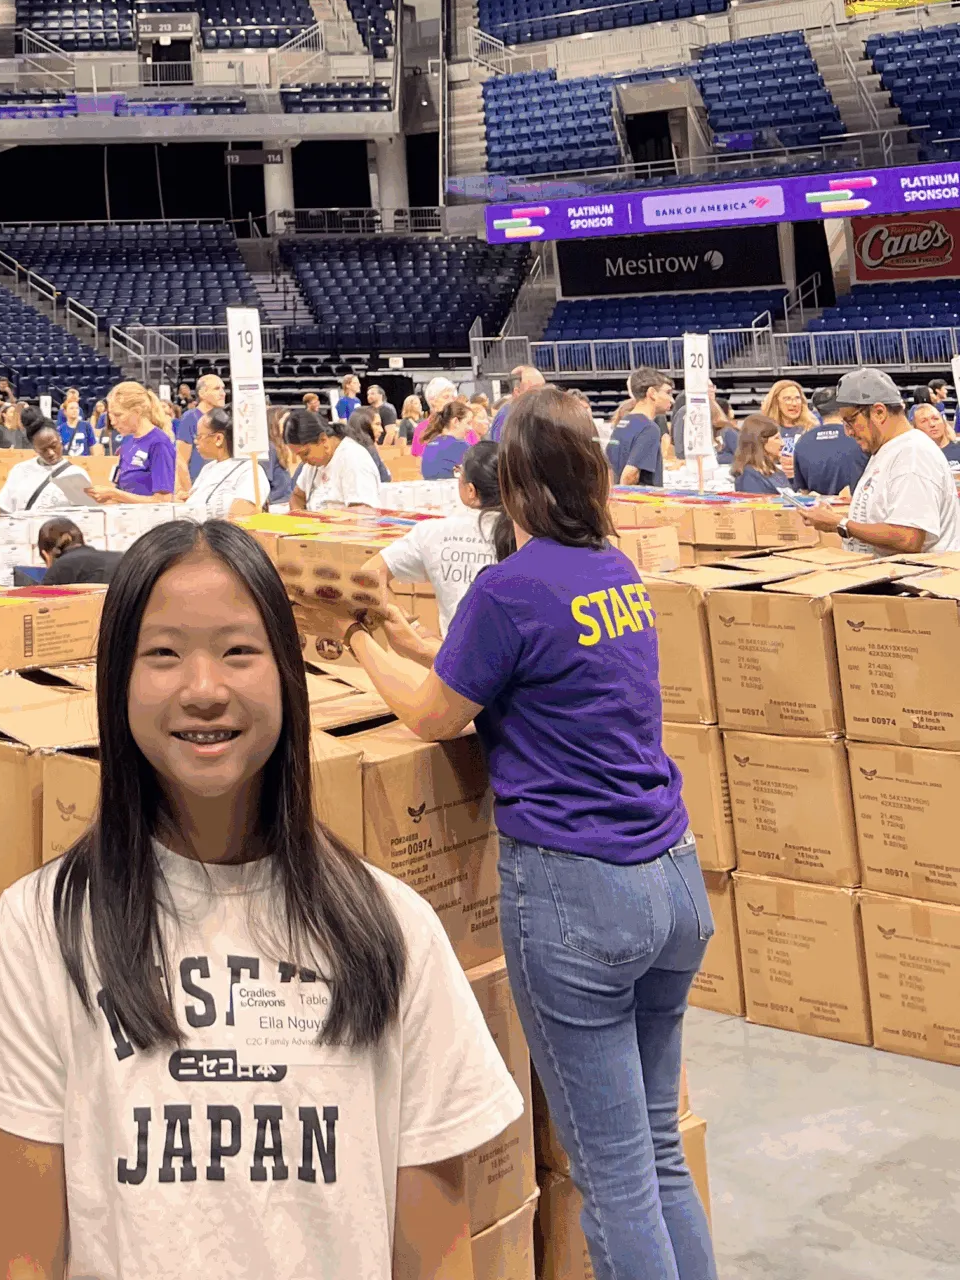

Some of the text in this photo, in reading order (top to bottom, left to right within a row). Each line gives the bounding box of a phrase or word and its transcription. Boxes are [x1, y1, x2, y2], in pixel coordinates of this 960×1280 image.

[226, 153, 281, 163] 113 114
[900, 172, 960, 189] PLATINUM
[903, 186, 960, 202] SPONSOR
[567, 204, 614, 217] PLATINUM
[655, 201, 747, 217] BANK OF AMERICA
[569, 216, 613, 230] SPONSOR
[605, 250, 698, 278] Mesirow
[237, 330, 253, 353] 19
[690, 353, 704, 368] 20
[571, 583, 655, 646] STAFF
[872, 716, 897, 726] 00974
[407, 838, 433, 855] 00974
[239, 988, 277, 998] Cradles
[299, 994, 328, 1005] Table
[259, 1016, 284, 1029] Ella
[245, 1038, 263, 1046] C2C
[264, 1038, 289, 1048] Family
[117, 1104, 339, 1185] JAPAN
